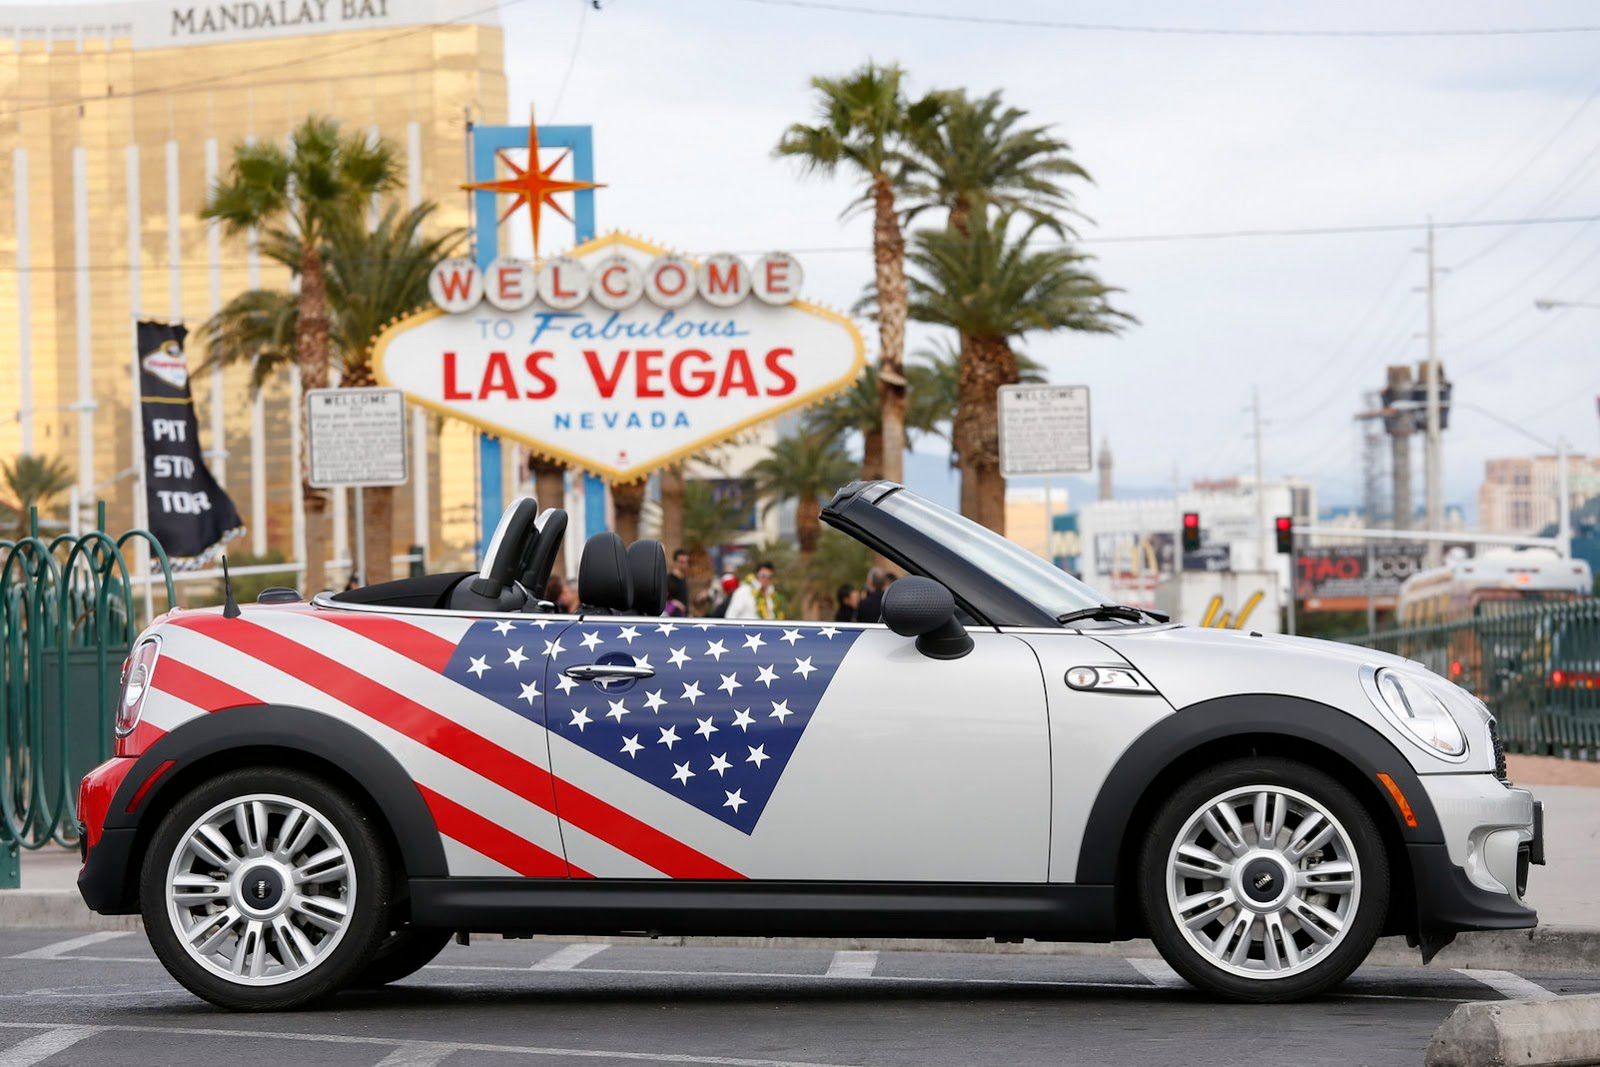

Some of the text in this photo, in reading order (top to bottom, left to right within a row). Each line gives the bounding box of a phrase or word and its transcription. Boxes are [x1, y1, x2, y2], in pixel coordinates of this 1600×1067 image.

[171, 0, 328, 36] MANDALAY
[437, 261, 790, 301] WELCOME
[476, 310, 750, 345] TO Fabulous
[443, 347, 797, 400] LAS VEGAS
[152, 418, 187, 442] PIT
[554, 410, 690, 430] NEVADA
[1298, 555, 1361, 580] TAO
[1254, 873, 1273, 889] MINI
